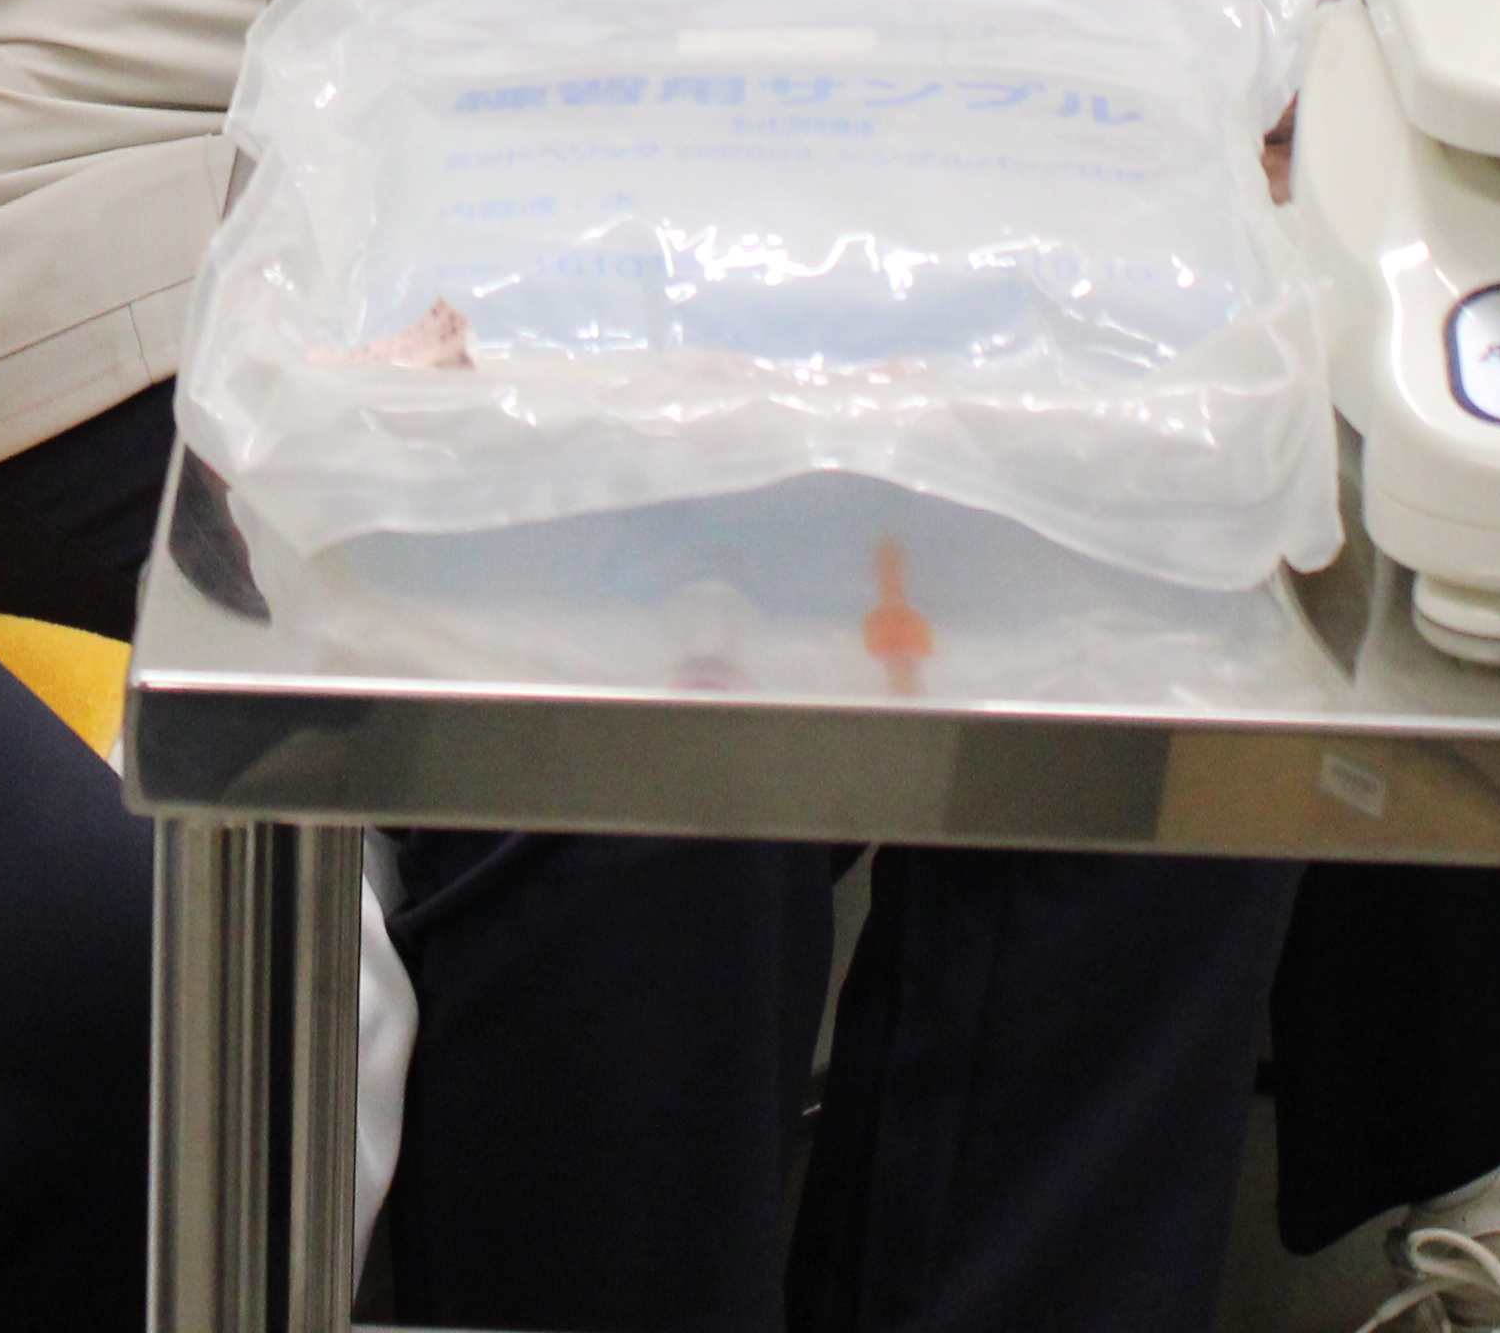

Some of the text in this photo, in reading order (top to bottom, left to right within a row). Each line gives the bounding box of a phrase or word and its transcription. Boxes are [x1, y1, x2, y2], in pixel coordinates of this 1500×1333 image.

[455, 75, 1144, 126] 練習用サンプル
